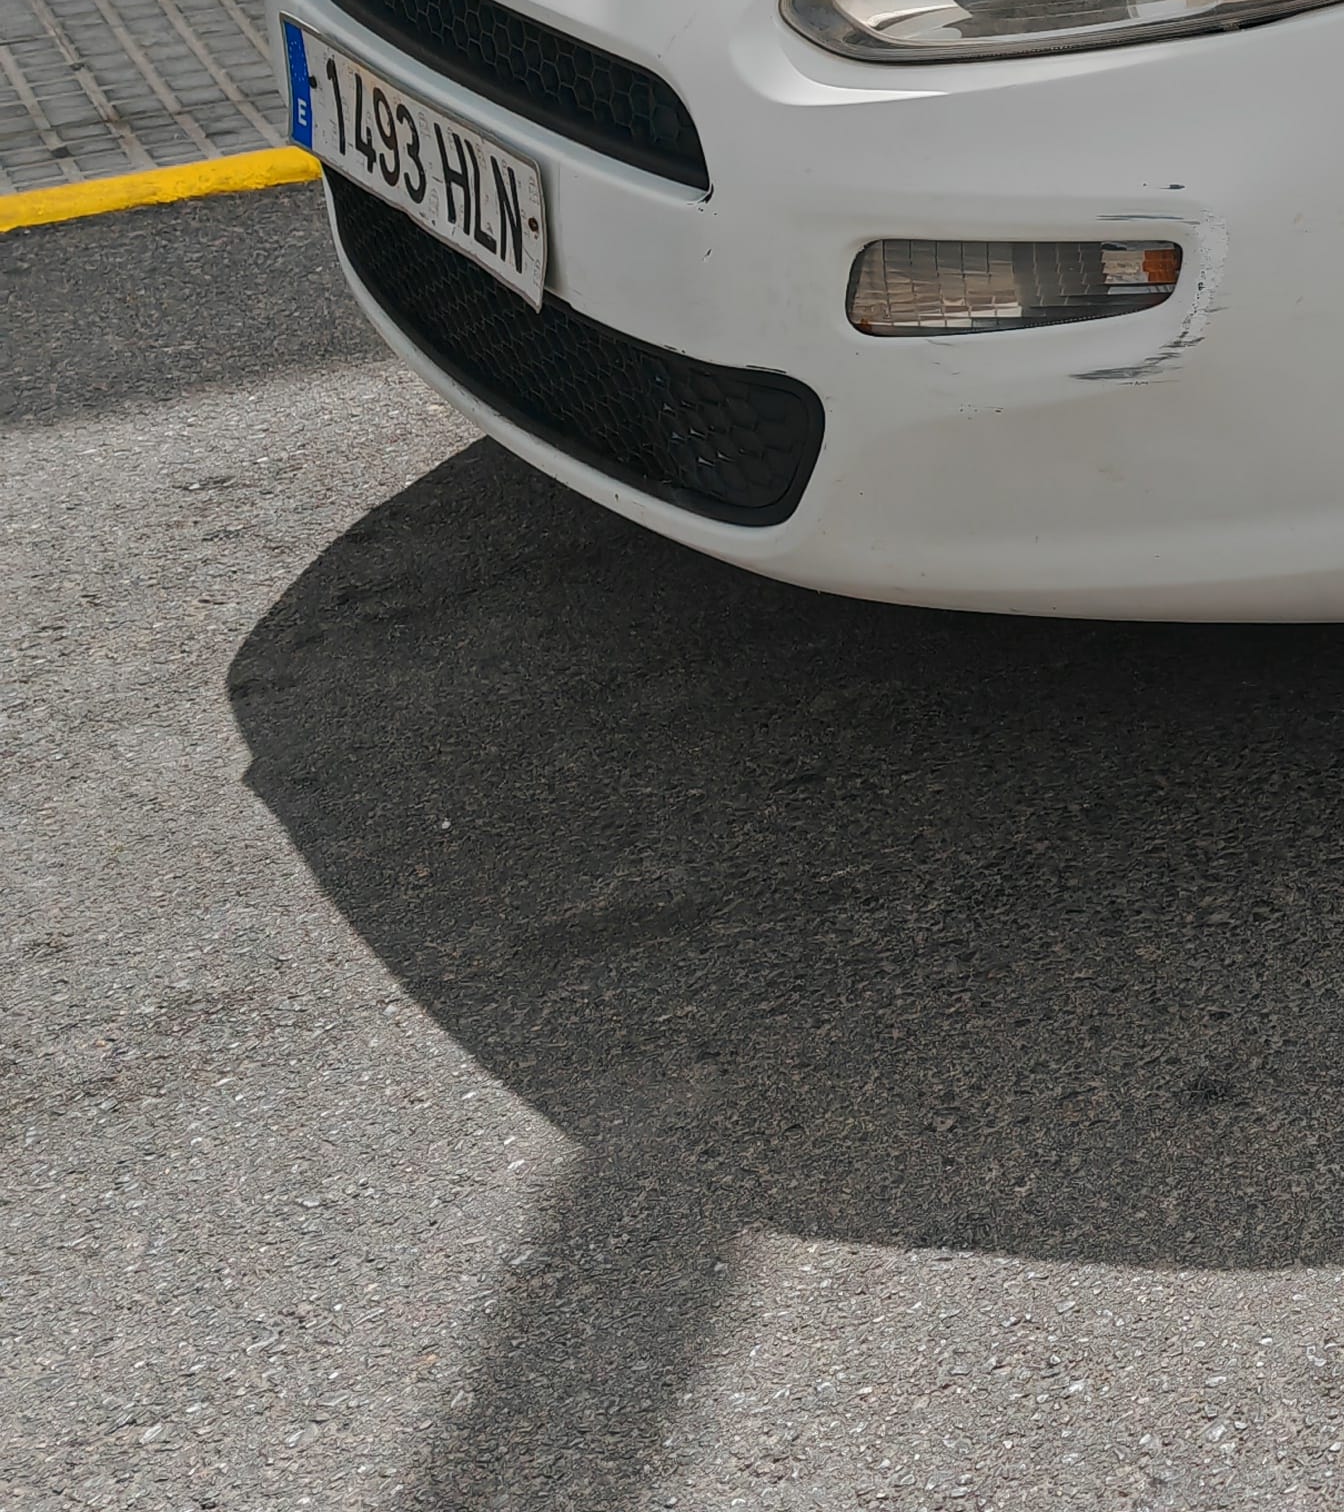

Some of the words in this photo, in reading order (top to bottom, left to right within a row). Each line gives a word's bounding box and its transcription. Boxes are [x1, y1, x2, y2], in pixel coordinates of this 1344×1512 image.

[298, 97, 307, 127] E
[326, 57, 427, 204] 1493
[433, 121, 523, 274] HLN
